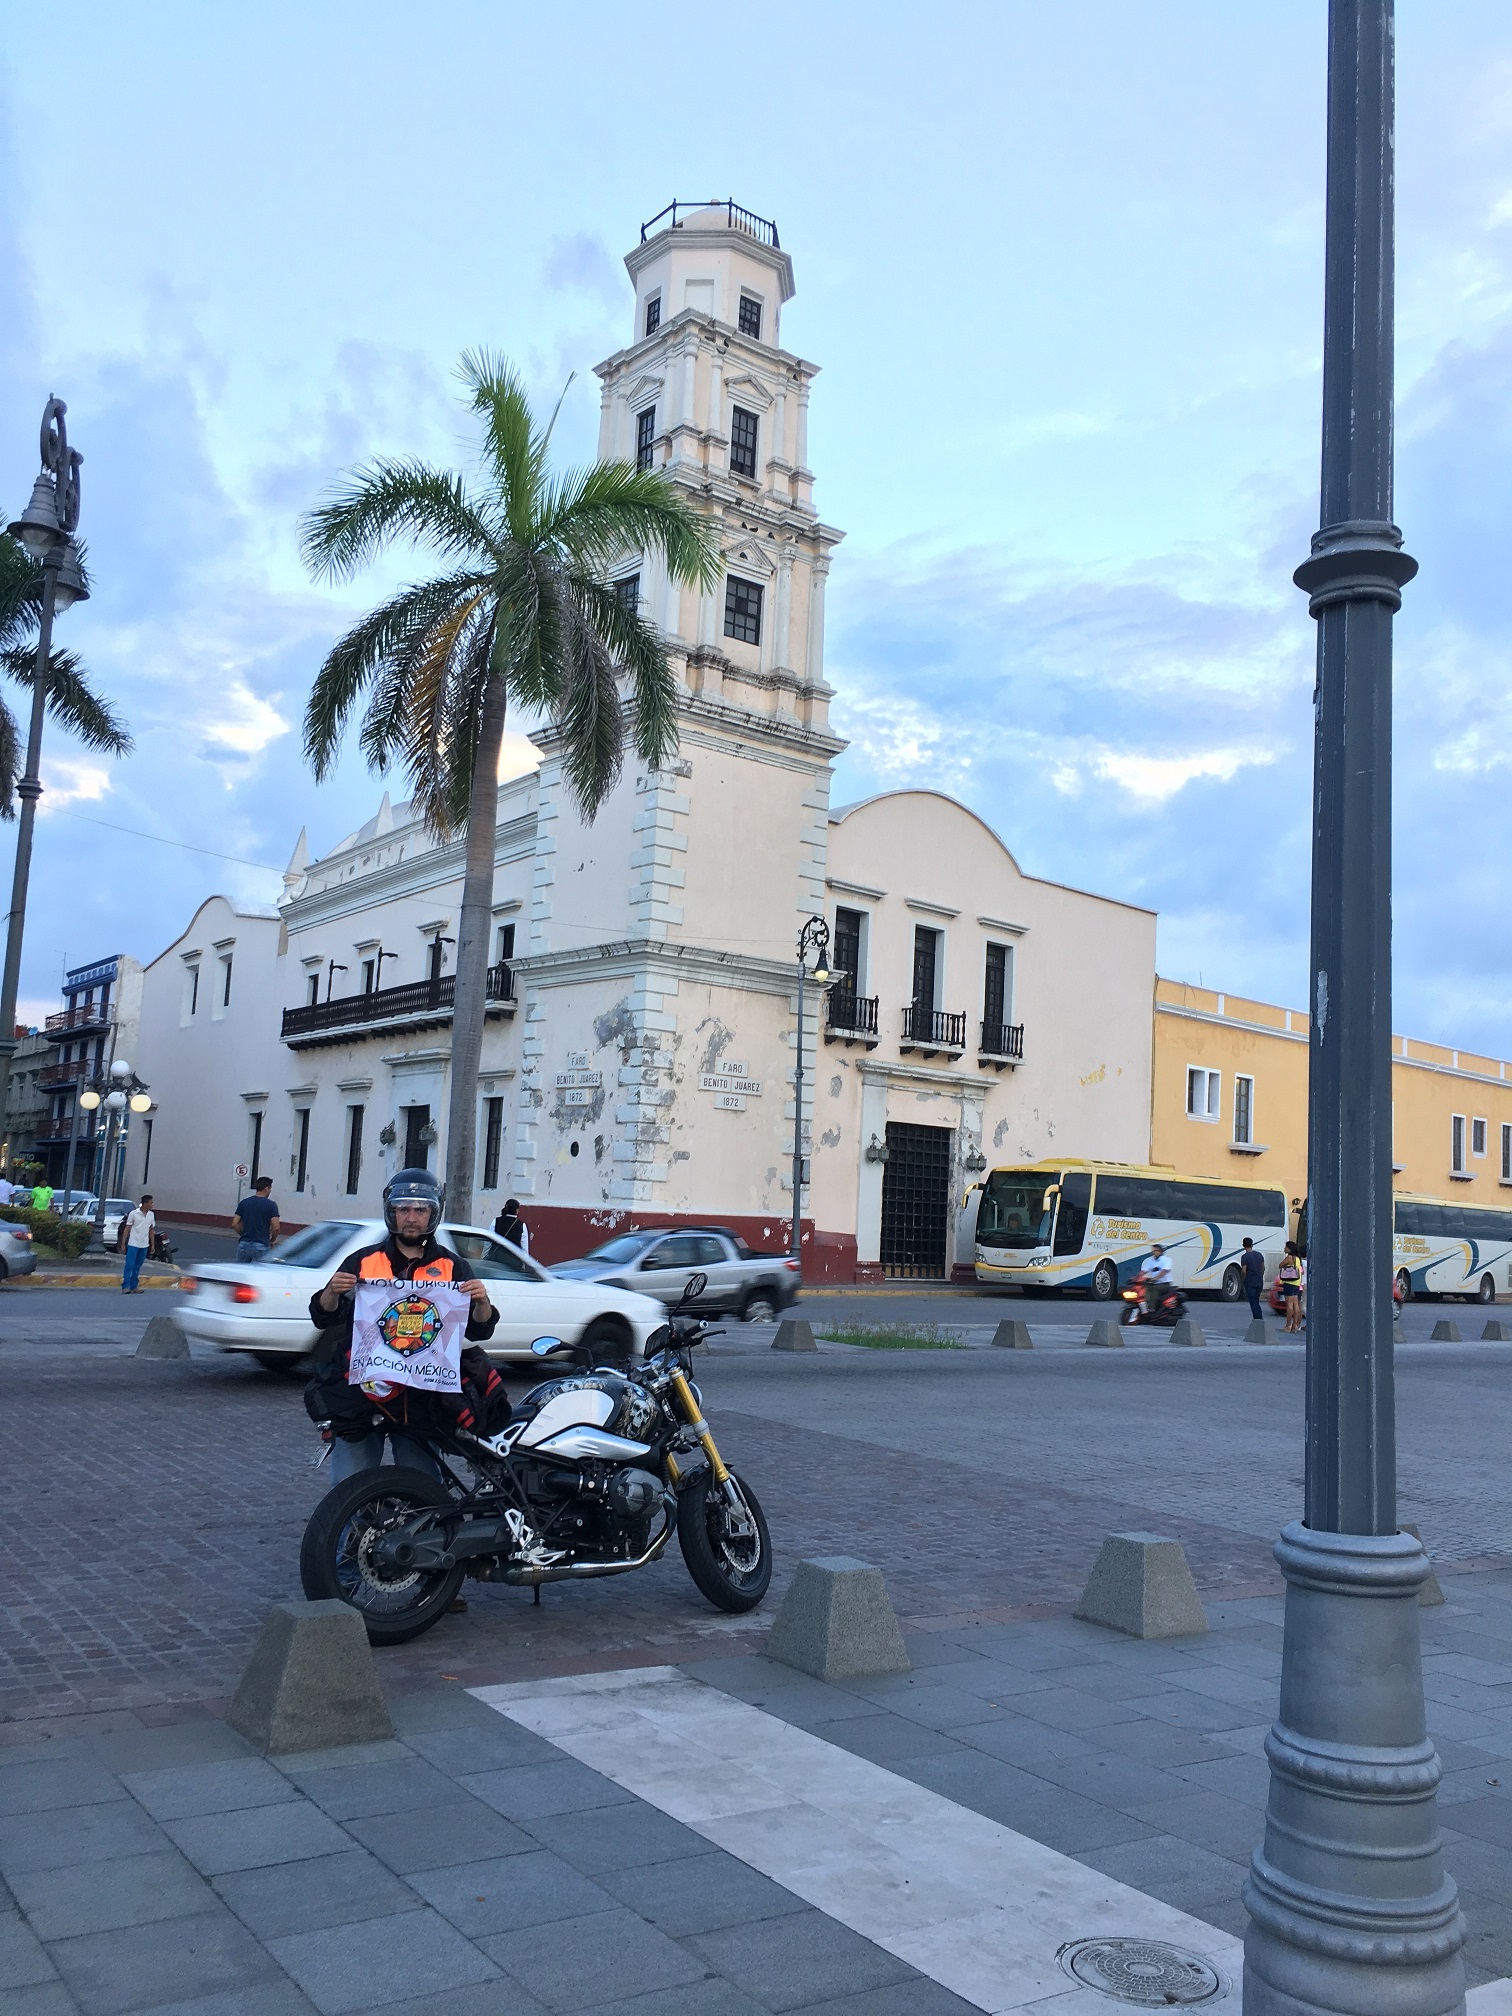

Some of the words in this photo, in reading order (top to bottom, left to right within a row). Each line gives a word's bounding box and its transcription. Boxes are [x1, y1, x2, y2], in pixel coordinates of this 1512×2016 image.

[571, 1056, 586, 1066] FARO
[722, 1062, 743, 1074] FARO
[556, 1074, 576, 1085] BENITO
[579, 1073, 599, 1084] JUAREZ
[703, 1077, 728, 1089] BENITO
[734, 1081, 760, 1092] JUAREZ
[569, 1092, 583, 1102] 1872
[723, 1096, 739, 1107] 1872
[1108, 1219, 1141, 1229] Turismo
[1106, 1229, 1119, 1239] del
[1121, 1230, 1148, 1240] Centro
[352, 1358, 365, 1370] EN
[366, 1356, 413, 1374] ACCIÓN
[415, 1362, 457, 1380] MÉXICO
